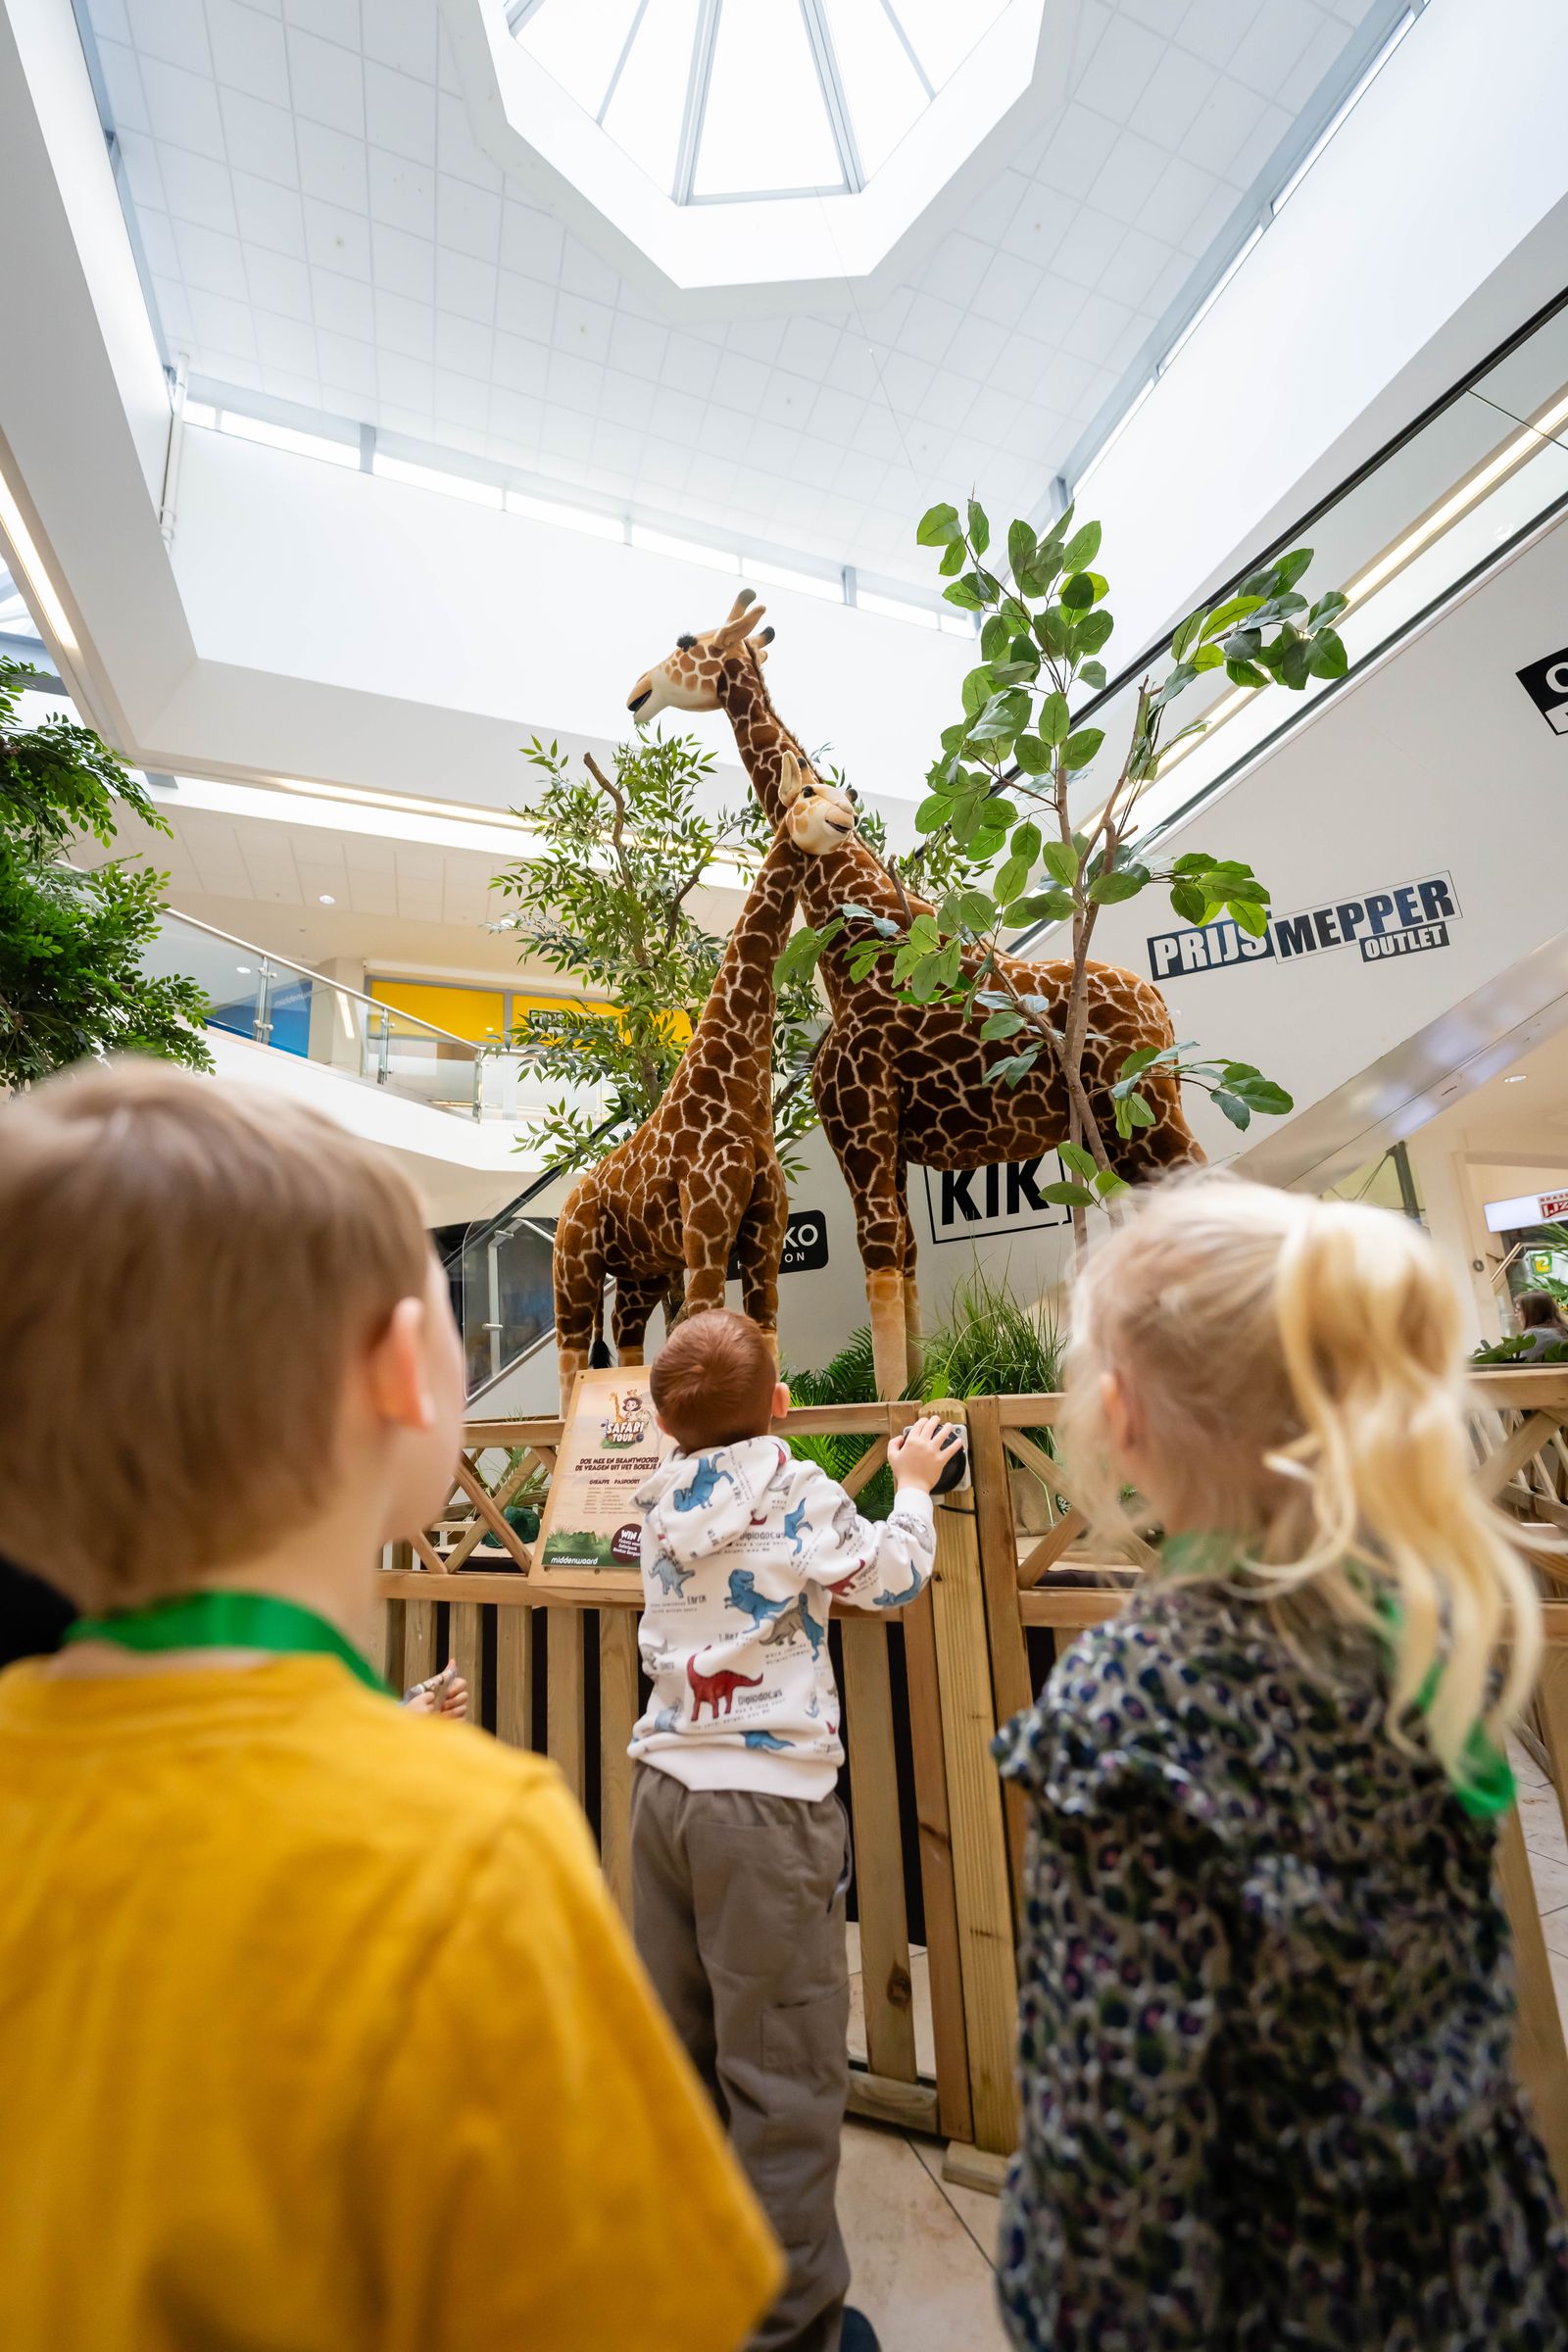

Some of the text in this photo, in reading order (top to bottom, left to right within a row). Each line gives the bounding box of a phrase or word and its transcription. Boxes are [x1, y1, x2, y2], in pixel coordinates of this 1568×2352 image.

[1364, 925, 1443, 958] OUTLET
[942, 1152, 1050, 1225] KIK
[608, 1421, 644, 1434] SAFARI
[612, 1434, 634, 1443] TOUR
[621, 1529, 638, 1541] WIN
[551, 1556, 598, 1565] middenwaard
